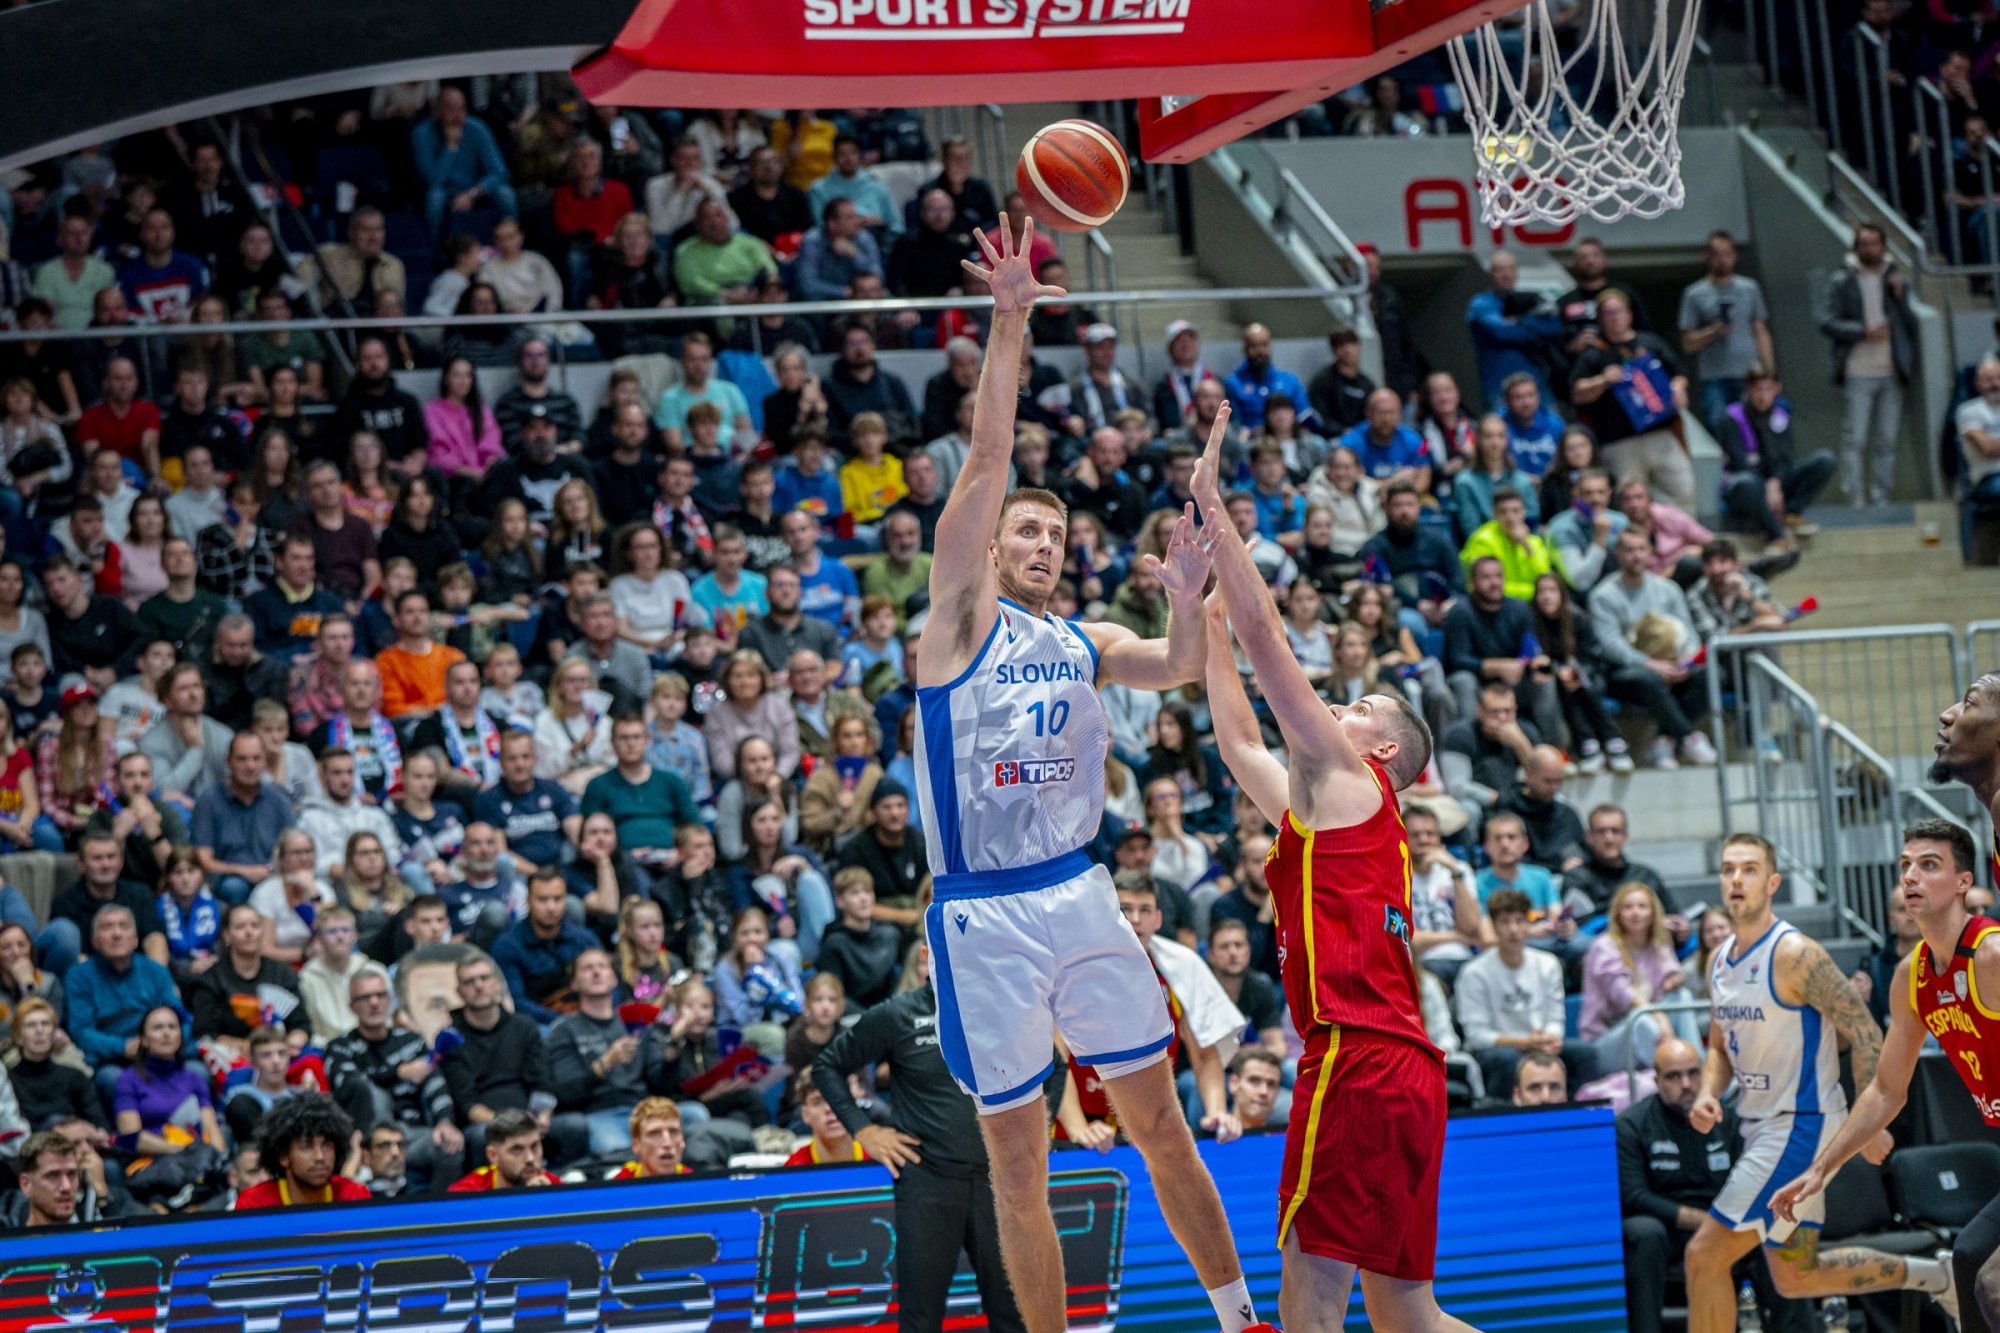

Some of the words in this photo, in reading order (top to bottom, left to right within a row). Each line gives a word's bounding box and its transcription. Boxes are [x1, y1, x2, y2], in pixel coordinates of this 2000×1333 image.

[1026, 700, 1070, 738] 10
[1023, 761, 1074, 783] TIPOS
[1925, 1004, 1982, 1039] ESPAÑA
[1959, 1050, 1983, 1081] 12
